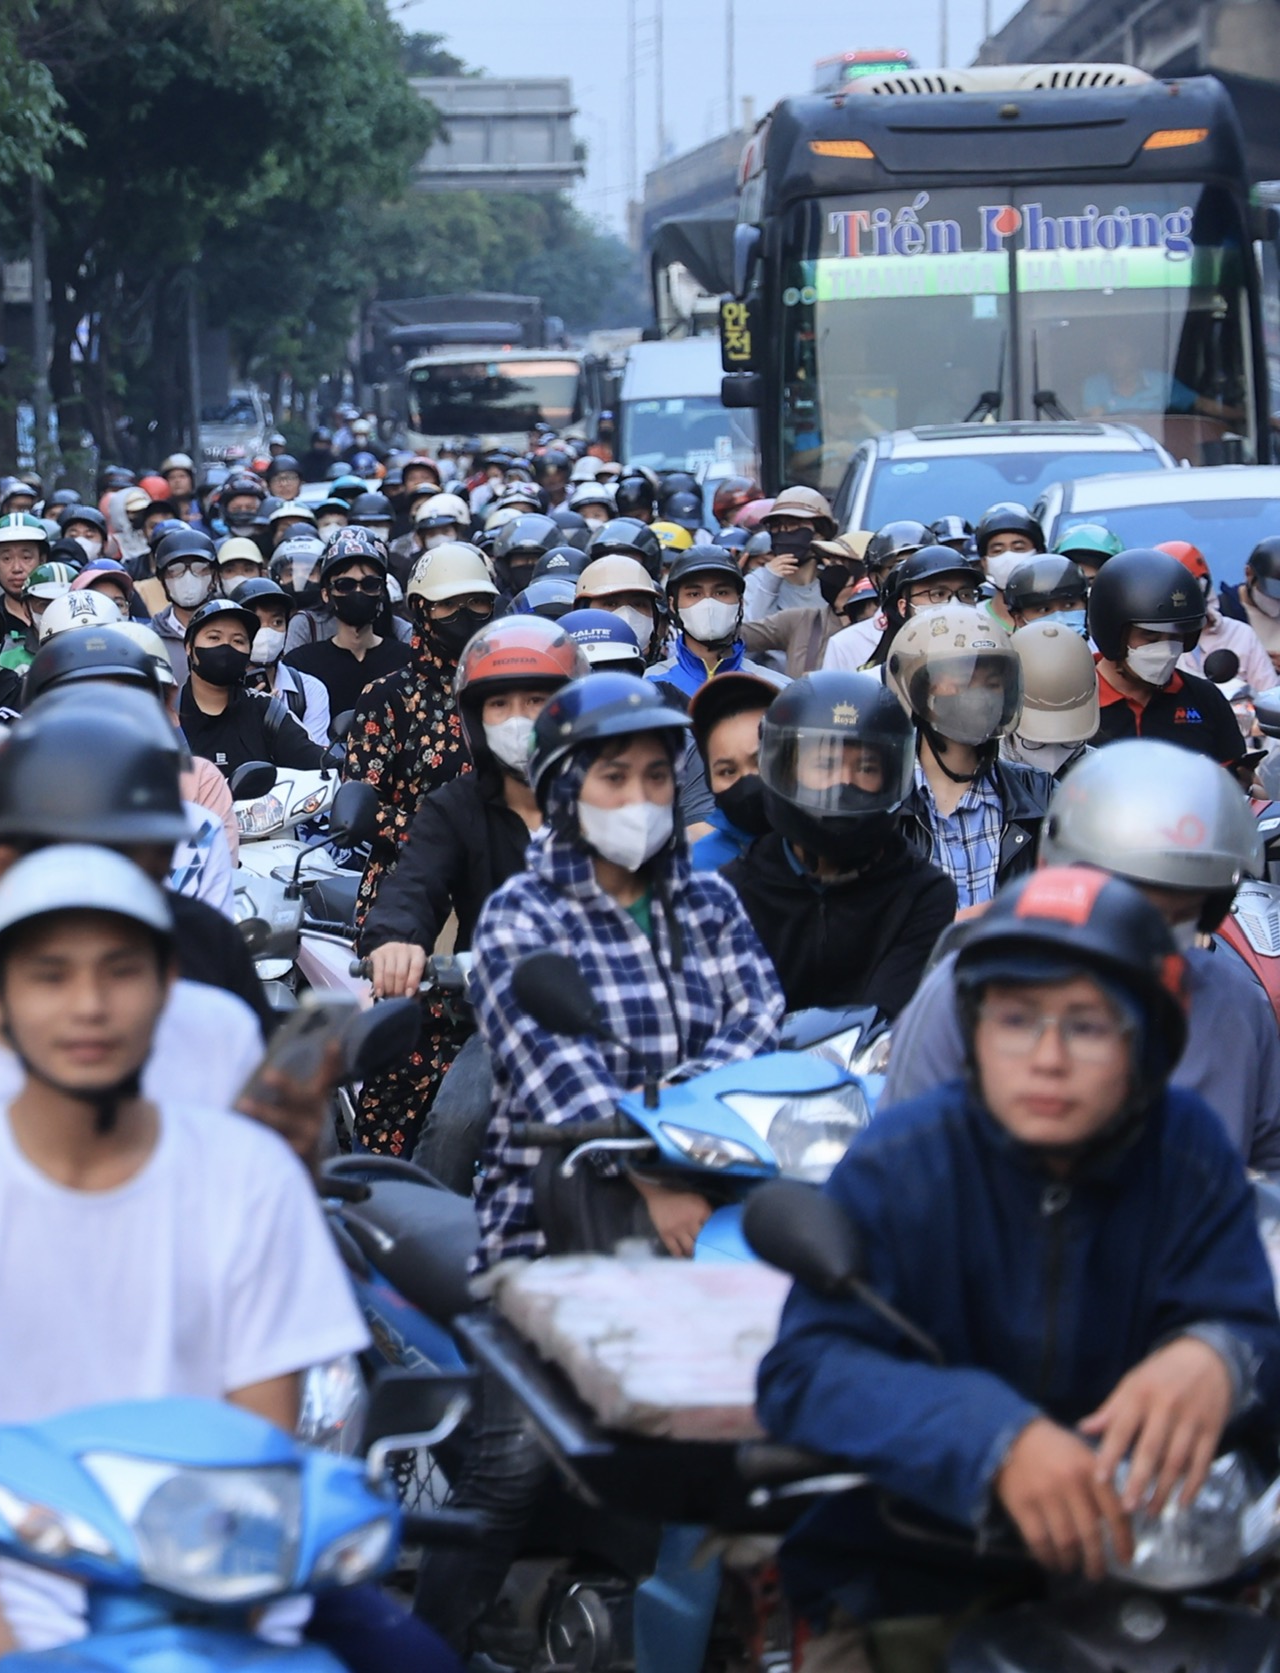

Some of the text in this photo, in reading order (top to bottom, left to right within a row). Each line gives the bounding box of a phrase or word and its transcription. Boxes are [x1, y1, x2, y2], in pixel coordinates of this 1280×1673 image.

[829, 192, 1194, 262] Tiến Phương
[827, 264, 925, 298] THANH
[722, 302, 751, 360] 안전
[492, 656, 537, 667] HONDA
